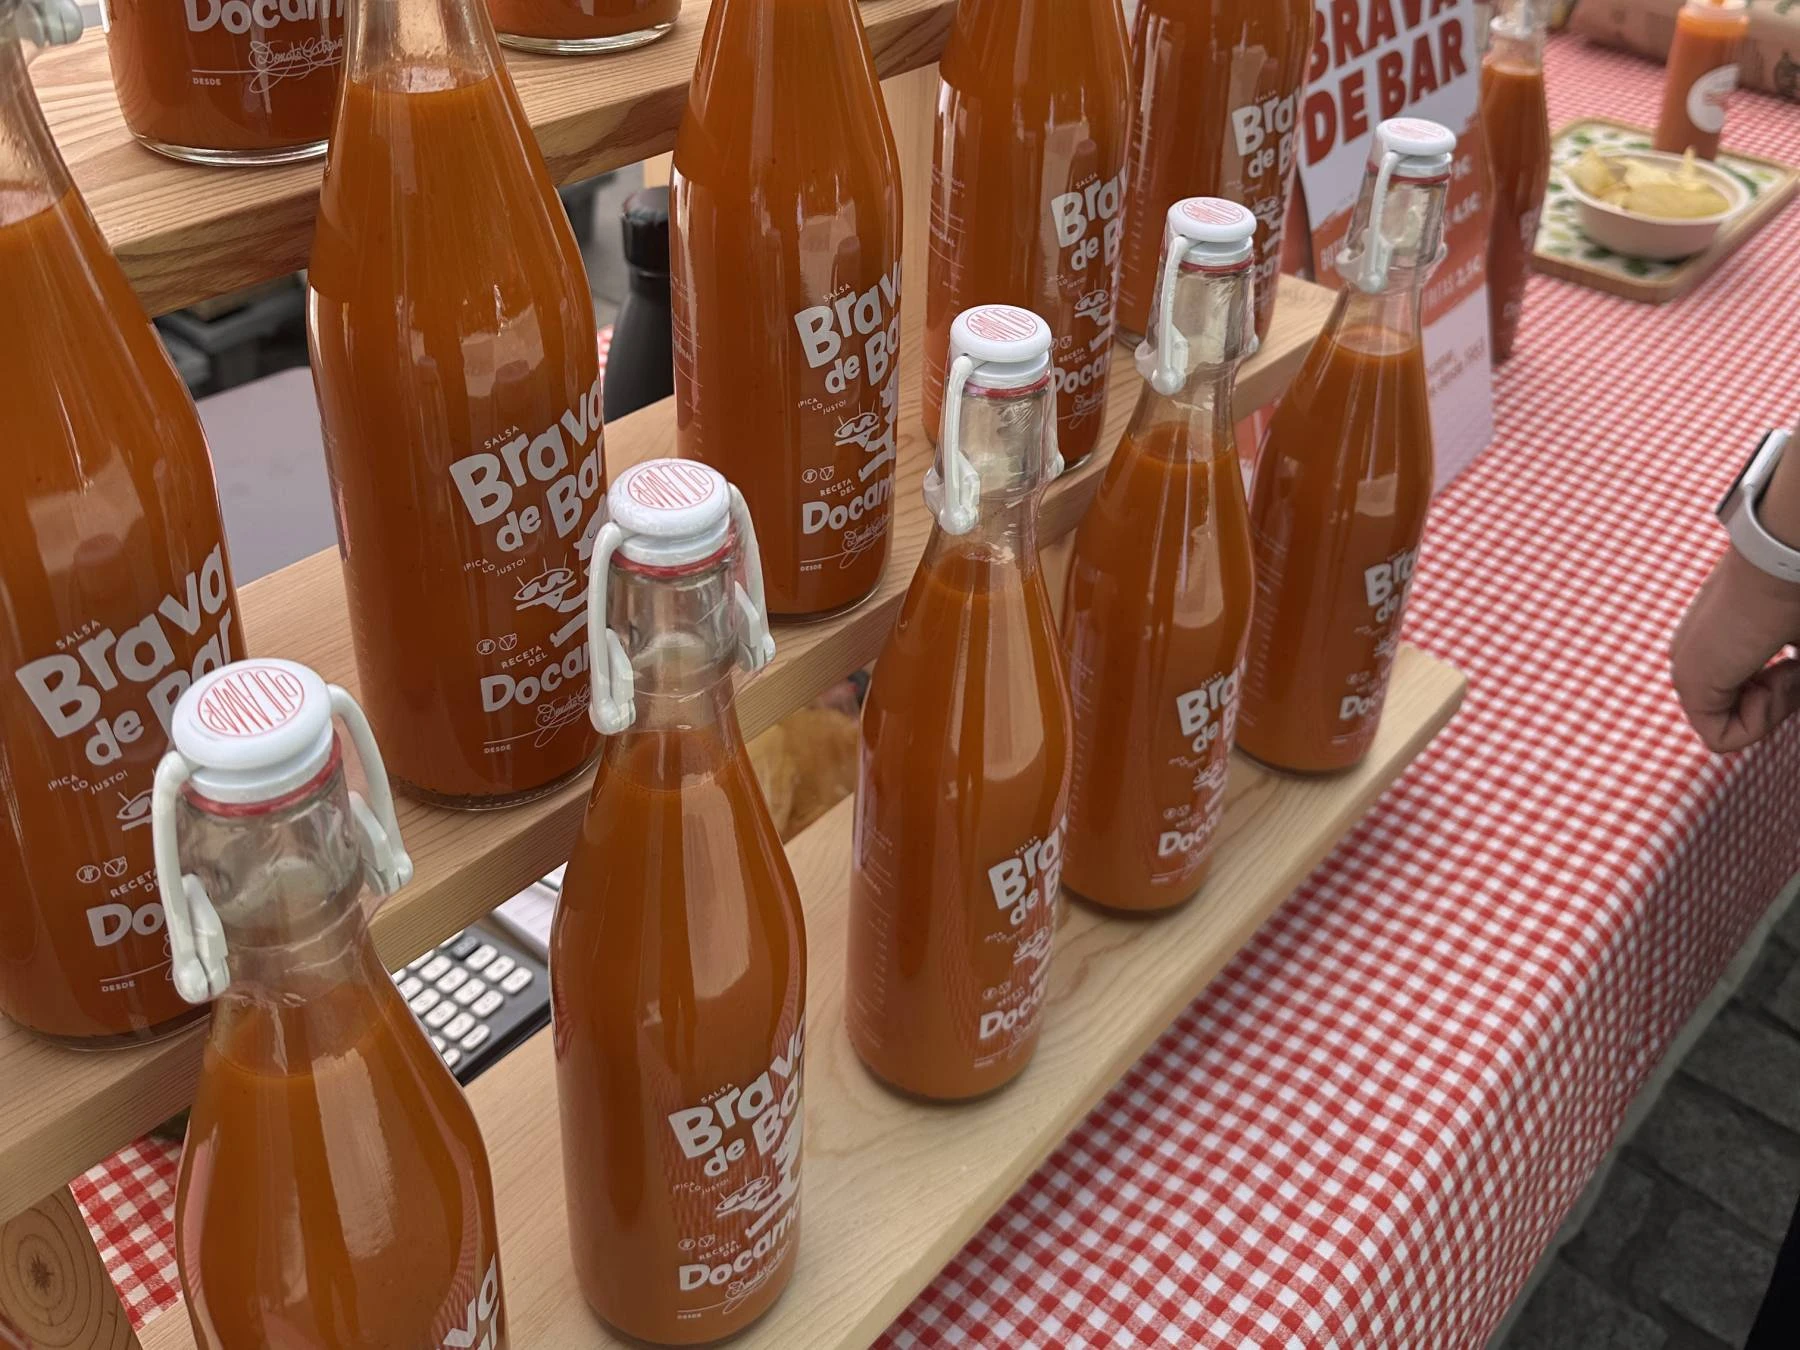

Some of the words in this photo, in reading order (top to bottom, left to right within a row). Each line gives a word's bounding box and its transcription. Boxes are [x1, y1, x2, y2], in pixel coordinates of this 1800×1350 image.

[1303, 69, 1369, 167] DE
[1378, 17, 1467, 120] BAR
[1248, 148, 1275, 178] de
[1071, 237, 1099, 271] de
[823, 283, 851, 303] SALSA
[825, 355, 861, 394] de
[449, 376, 603, 525] Brava
[484, 425, 519, 450] SALSA
[820, 478, 852, 497] RECETA
[840, 485, 856, 497] DEL
[496, 505, 542, 552] de
[482, 563, 496, 574] LO
[496, 557, 527, 577] JUSTO!
[15, 542, 228, 739] Brava
[55, 619, 101, 650] SALSA
[501, 645, 542, 669] RECETA
[528, 652, 549, 668] DEL
[85, 709, 145, 766] de
[1192, 720, 1219, 753] de
[71, 780, 89, 792] LO
[90, 769, 128, 795] JUSTO!
[1010, 888, 1040, 926] de
[701, 1082, 734, 1104] SALSA
[704, 1138, 746, 1177] de
